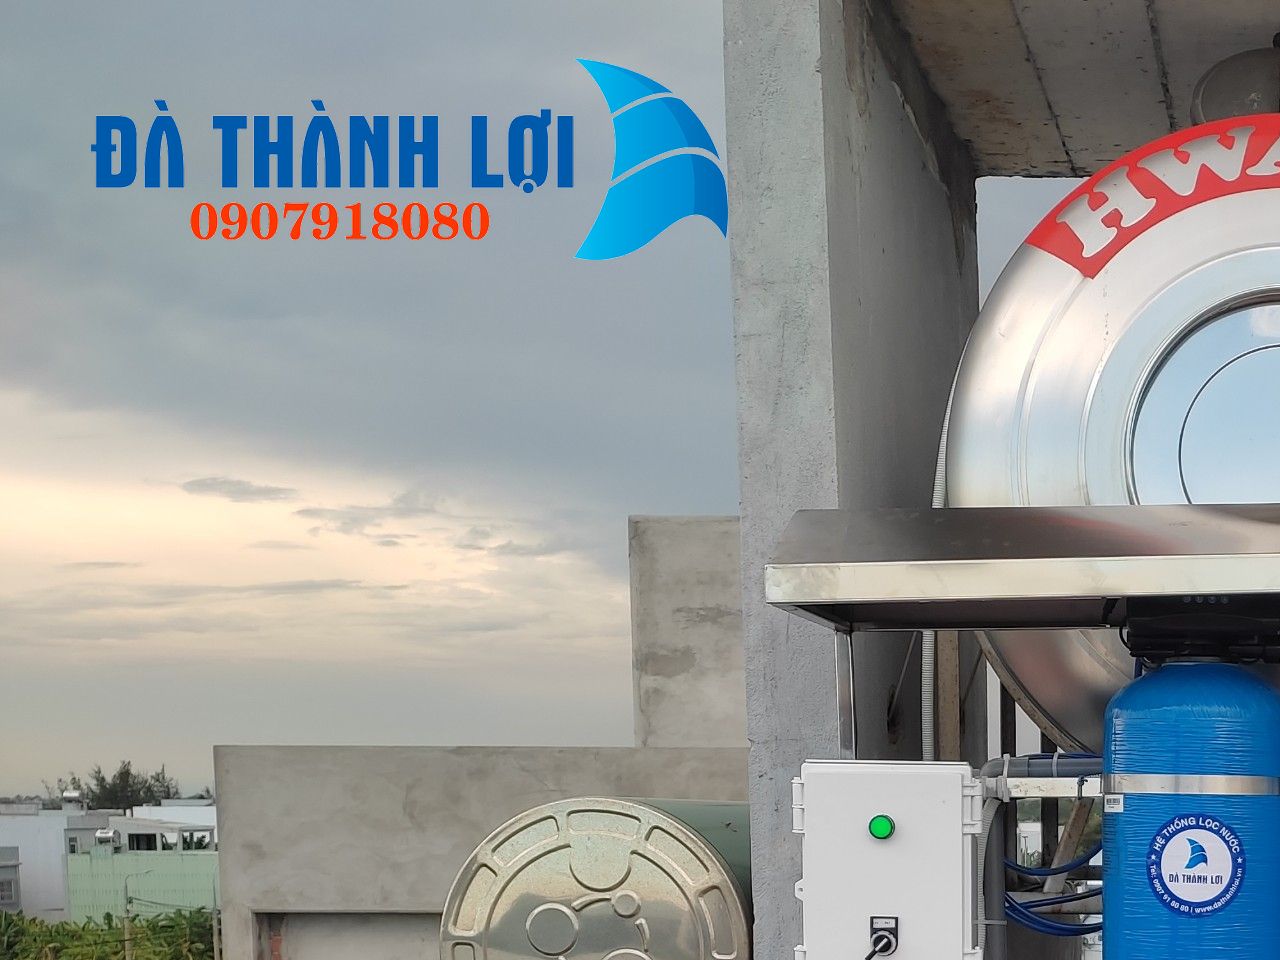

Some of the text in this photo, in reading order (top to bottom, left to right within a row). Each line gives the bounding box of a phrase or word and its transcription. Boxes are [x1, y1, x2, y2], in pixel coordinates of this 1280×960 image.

[1153, 817, 1240, 854] HỆ THỐNG LỌC NƯỚC
